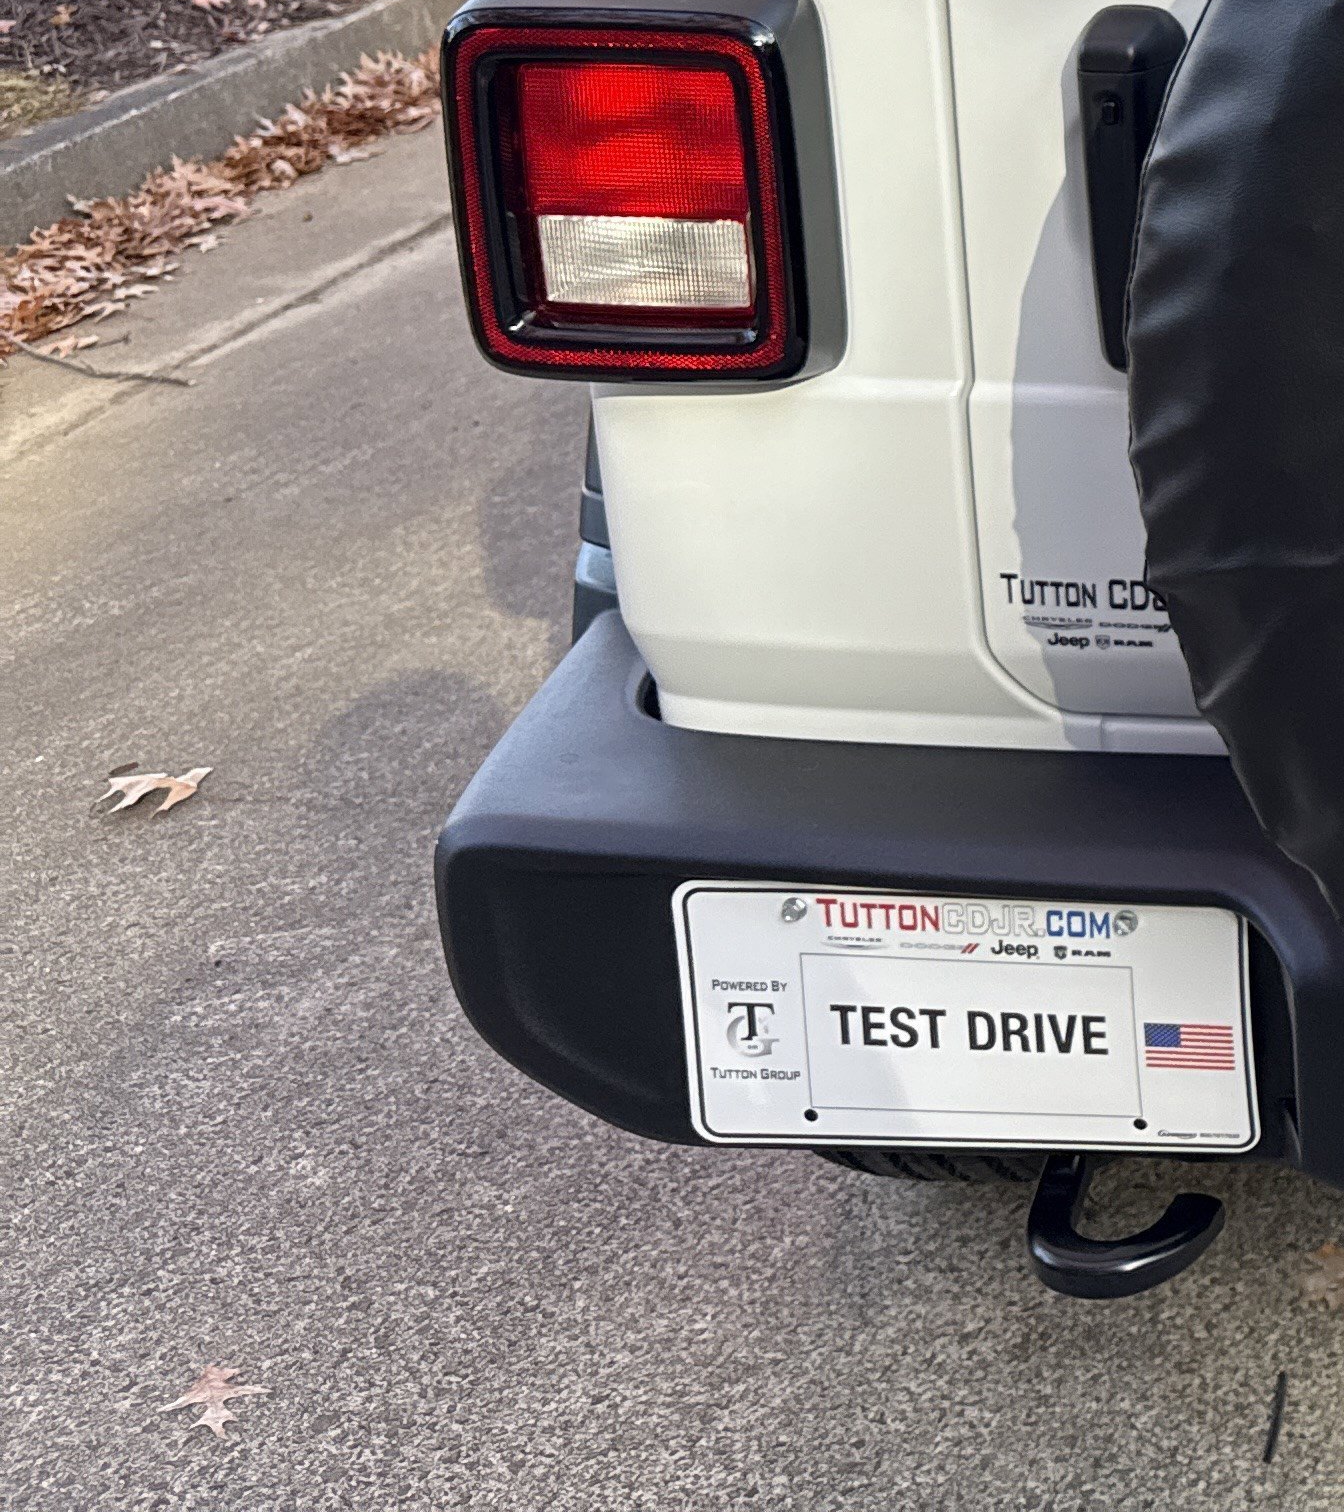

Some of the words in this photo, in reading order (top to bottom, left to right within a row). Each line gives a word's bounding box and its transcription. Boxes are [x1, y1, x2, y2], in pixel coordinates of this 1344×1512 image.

[1000, 573, 1097, 609] TUTTON
[1048, 632, 1091, 650] Jeep
[1113, 639, 1154, 648] RAM
[816, 898, 1112, 938] TUTTONCDJR.COM
[991, 939, 1039, 959] Jeep
[1071, 949, 1112, 957] RAM
[830, 1004, 947, 1049] TEST
[966, 1010, 1109, 1055] DRIVE
